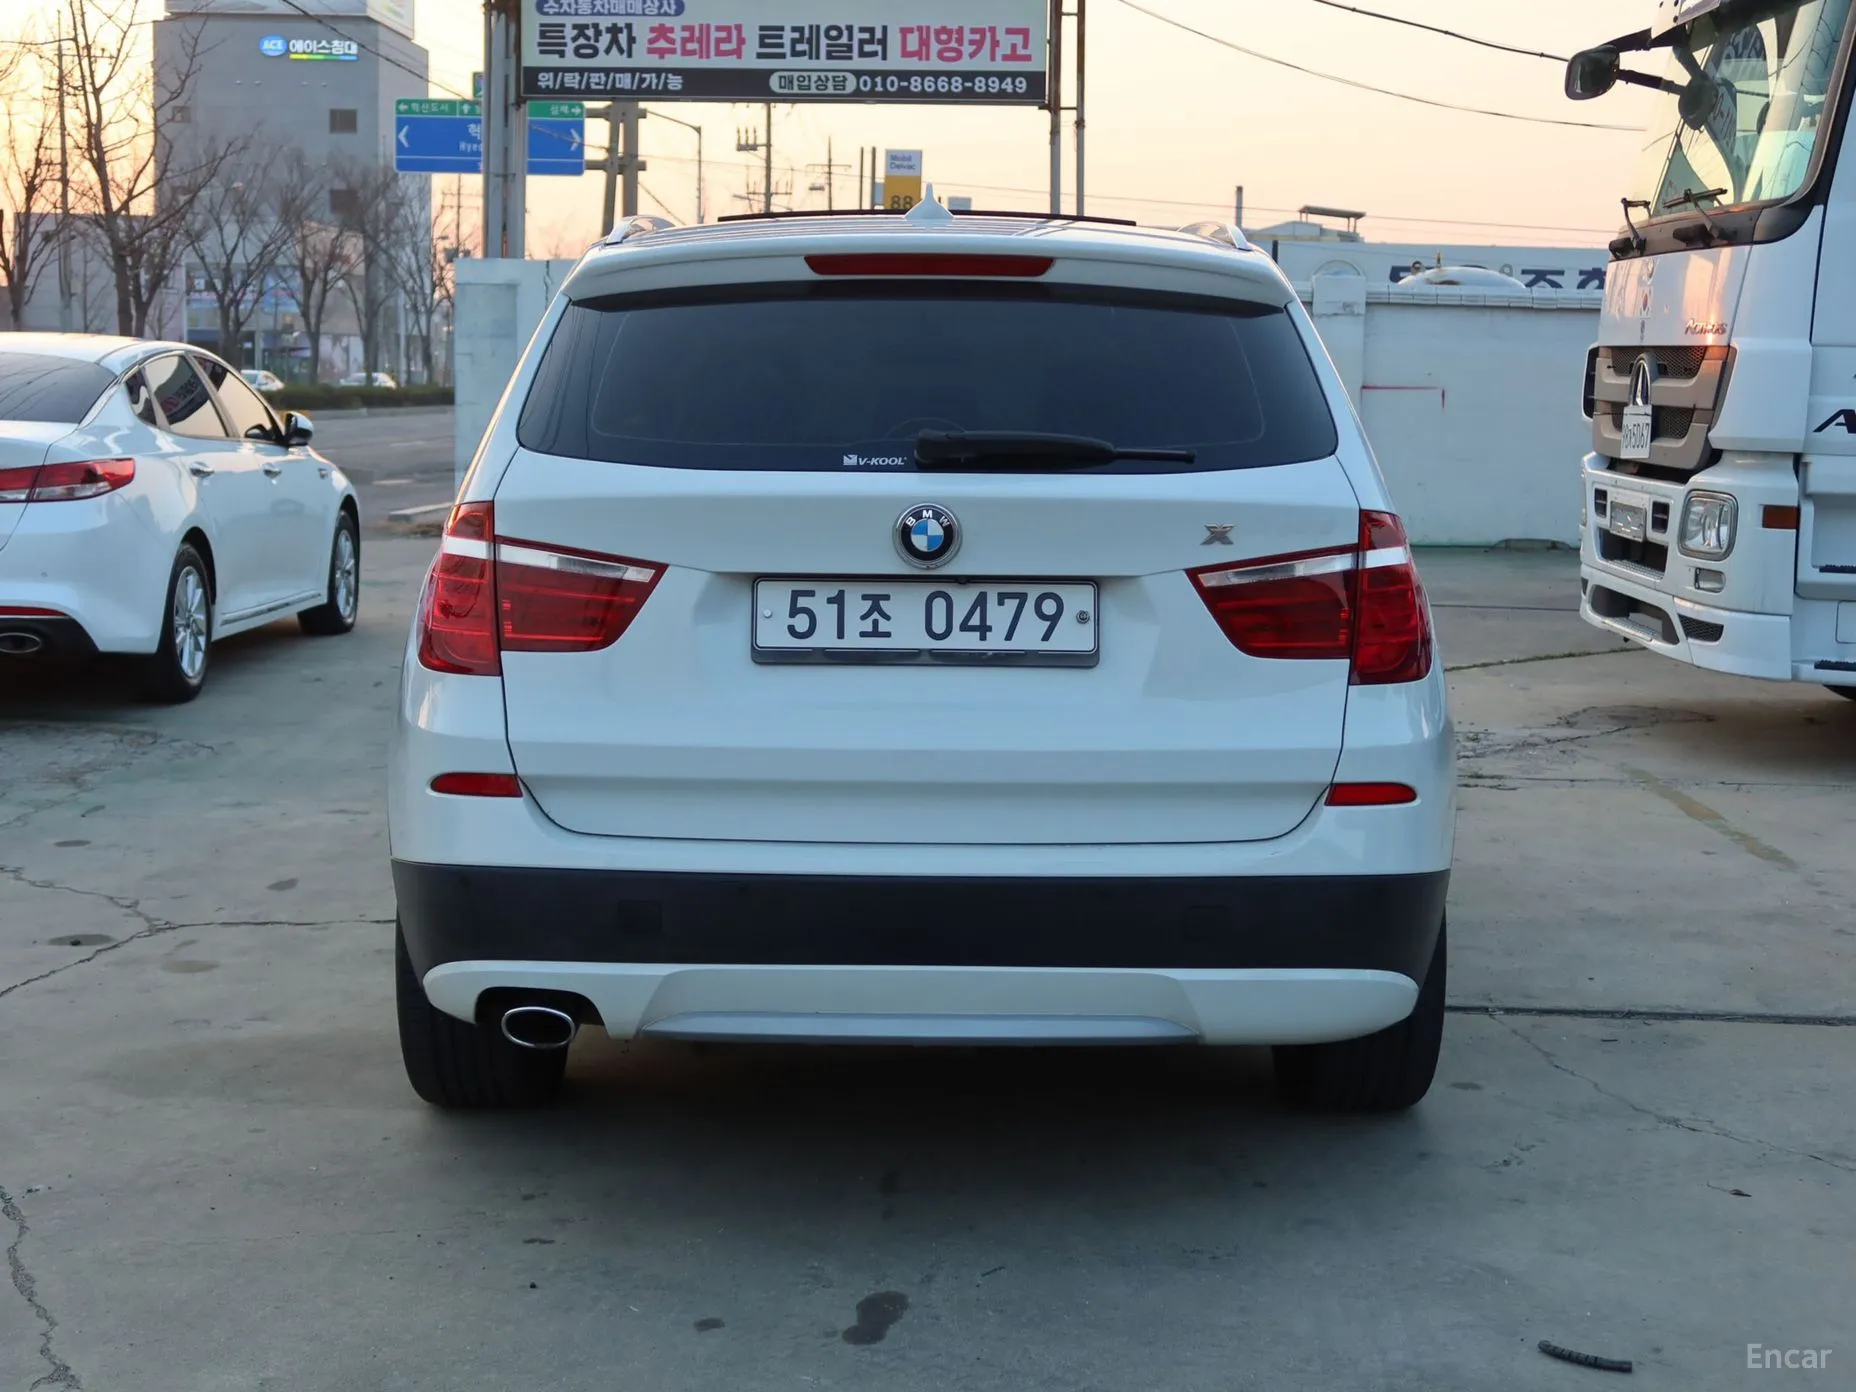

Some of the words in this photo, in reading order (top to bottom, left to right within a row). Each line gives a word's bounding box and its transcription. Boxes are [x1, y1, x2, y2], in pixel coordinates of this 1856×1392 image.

[289, 39, 358, 55] 에이스침대
[537, 22, 637, 59] 특장차
[646, 23, 747, 60] 추레라
[756, 24, 888, 61] 트레일러
[899, 25, 1033, 62] 대형카고
[537, 72, 684, 90] 위/락/판/매/가/능
[778, 75, 848, 91] 매입상담
[859, 75, 1027, 93] 010-8668-8949
[858, 457, 905, 466] V-KOOL
[905, 509, 950, 527] BMW
[787, 589, 892, 640] 51조
[924, 590, 1064, 642] 0479
